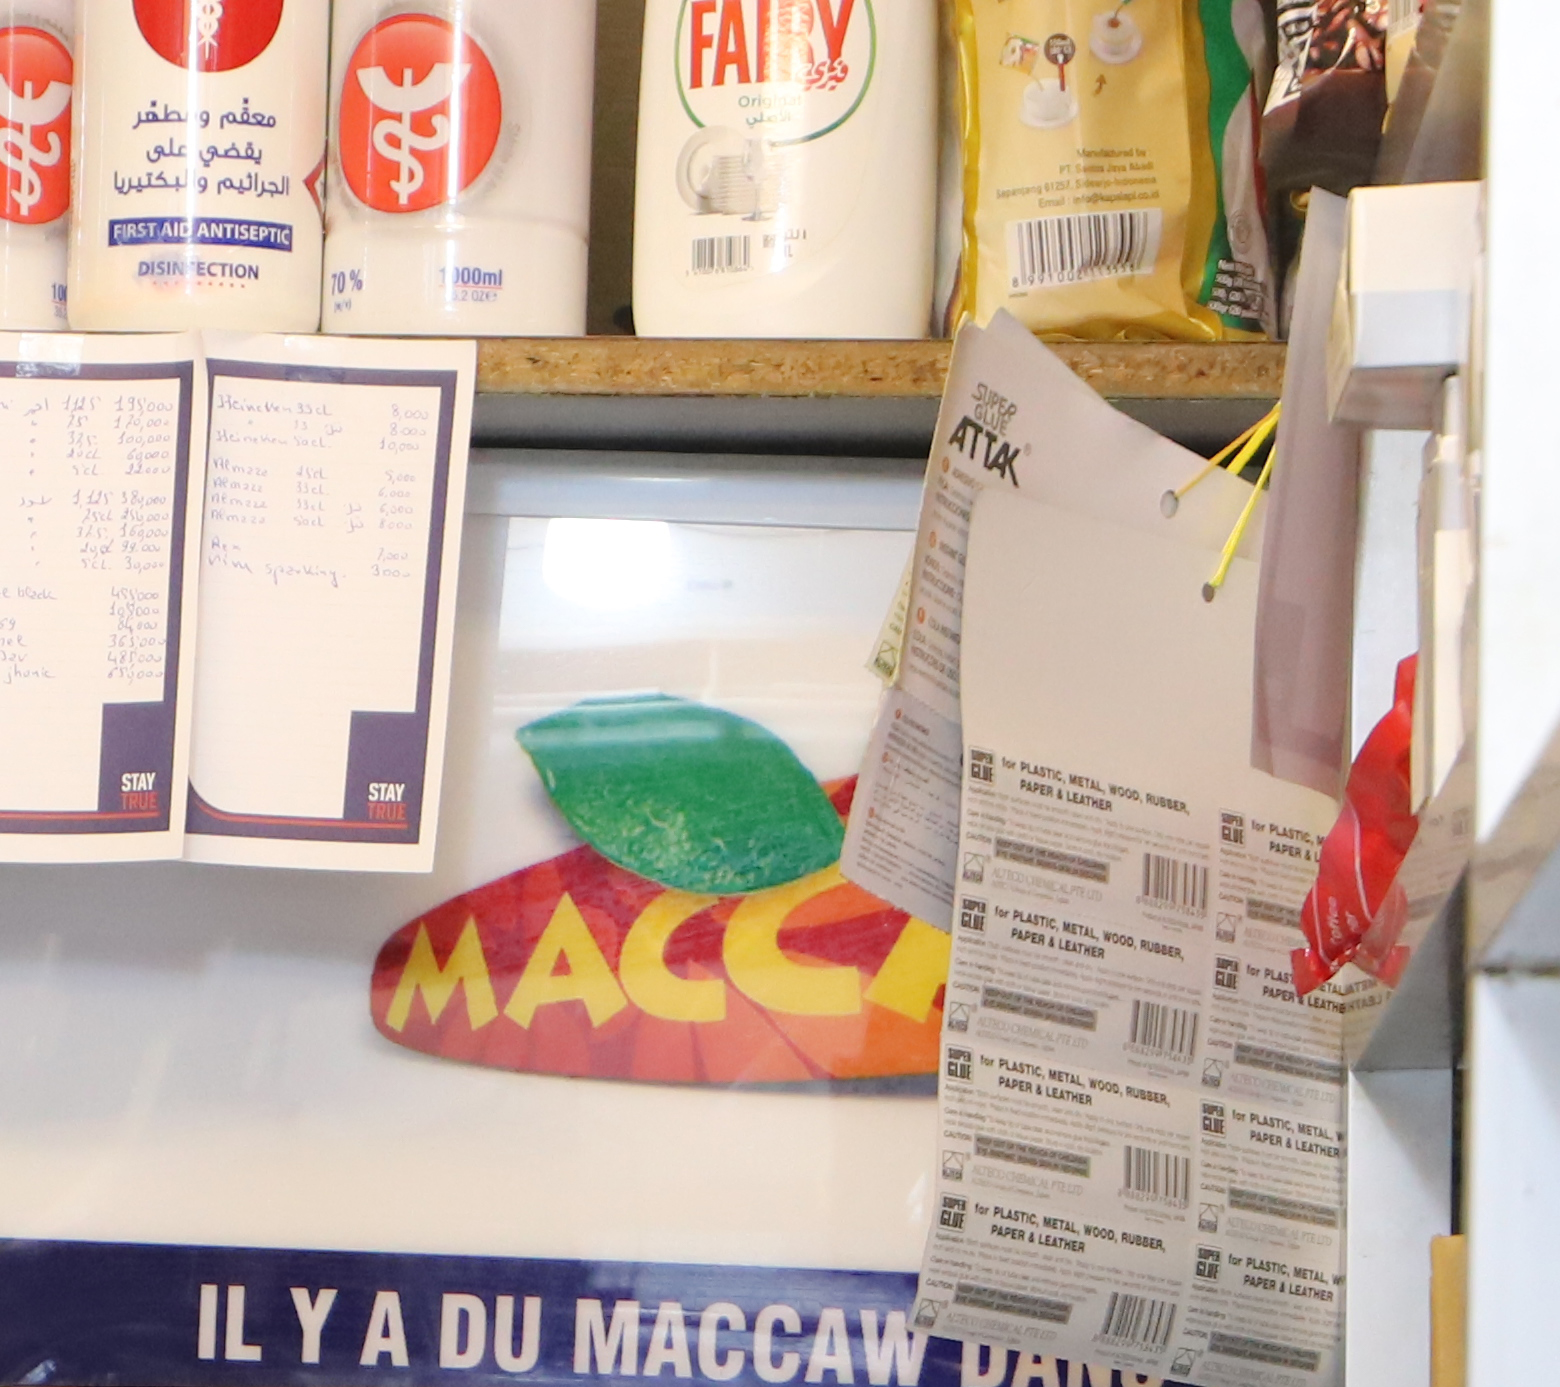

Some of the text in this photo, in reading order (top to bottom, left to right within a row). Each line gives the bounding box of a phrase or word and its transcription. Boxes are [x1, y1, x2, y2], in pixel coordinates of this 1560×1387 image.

[113, 223, 157, 241] FIRST
[197, 220, 291, 246] ANTISEPTIC
[971, 383, 1017, 419] SUPER
[974, 403, 1008, 437] GLUE
[948, 415, 1022, 489] ATTAK
[121, 772, 156, 793] STAY
[368, 782, 405, 802] STAY
[1002, 756, 1016, 770] for
[1020, 762, 1066, 785] PLASTIC,
[1108, 784, 1142, 804] WOOD,
[1020, 780, 1113, 812] PAPER LEATHER
[120, 791, 159, 812] TRUE
[367, 801, 408, 821] TRUE
[995, 905, 1009, 919] for
[1013, 910, 1059, 932] PLASTIC,
[1103, 930, 1137, 950] WOOD,
[1011, 928, 1105, 959] PAPER LEATHER
[980, 1054, 995, 1067] for
[998, 1058, 1045, 1080] PLASTIC,
[1089, 1078, 1123, 1097] WOOD,
[998, 1077, 1092, 1106] PAPER LEATHER
[975, 1203, 989, 1216] for
[993, 1206, 1039, 1228] PLASTIC,
[1083, 1223, 1117, 1243] WOOD,
[991, 1225, 1086, 1253] PAPER LEATHER
[196, 1283, 264, 1363] IL
[290, 1288, 341, 1368] Y
[359, 1292, 412, 1370] A
[439, 1294, 540, 1375] DU
